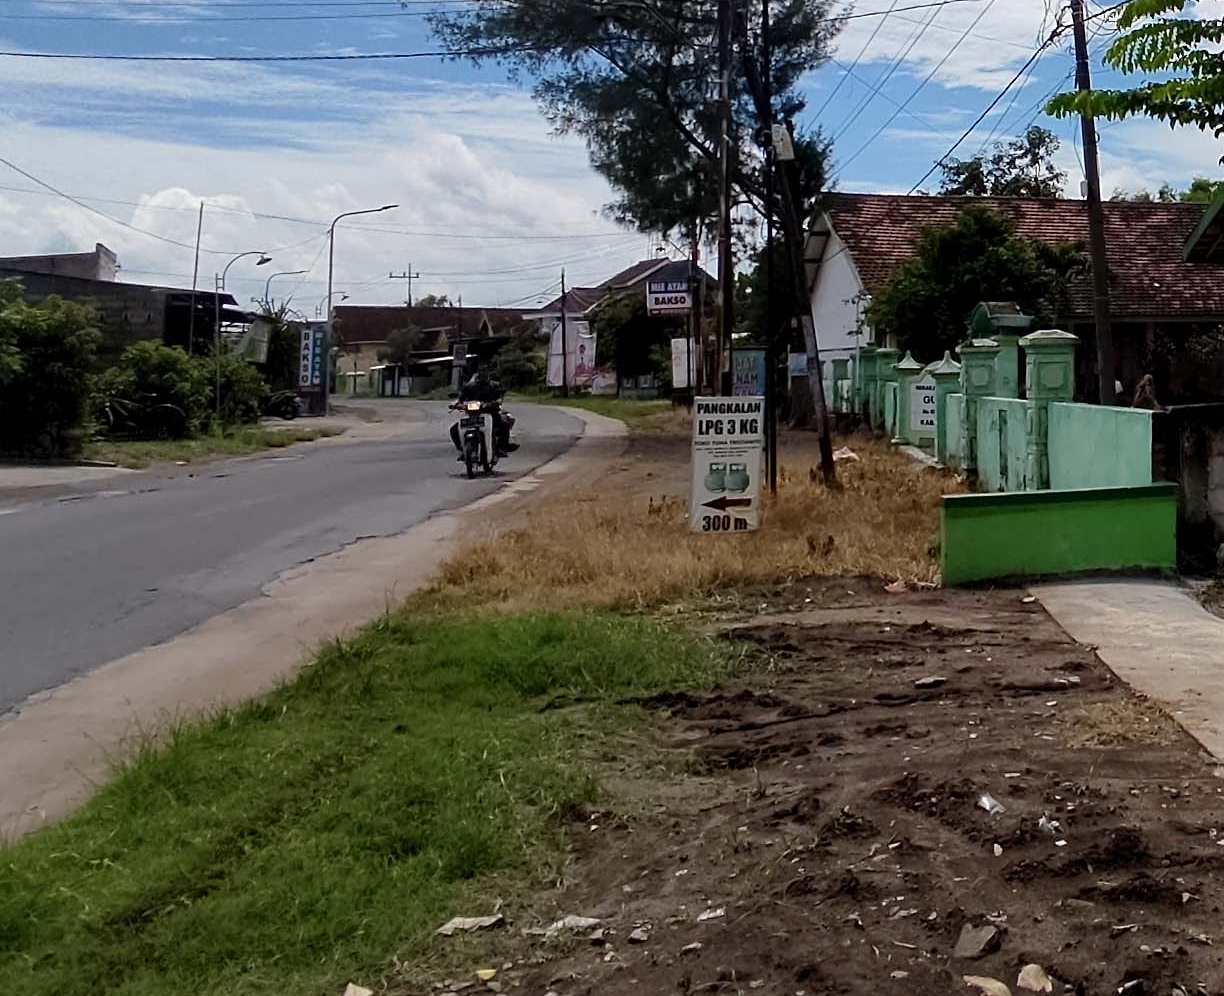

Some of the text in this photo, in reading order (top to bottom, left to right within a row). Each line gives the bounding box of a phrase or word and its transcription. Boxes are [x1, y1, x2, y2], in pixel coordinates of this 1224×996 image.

[654, 295, 686, 306] BAKSO
[302, 331, 310, 384] BAKSO
[697, 402, 761, 415] PANGKALAN
[698, 418, 759, 436] LPG 3 KG
[702, 514, 748, 532] 300 m
